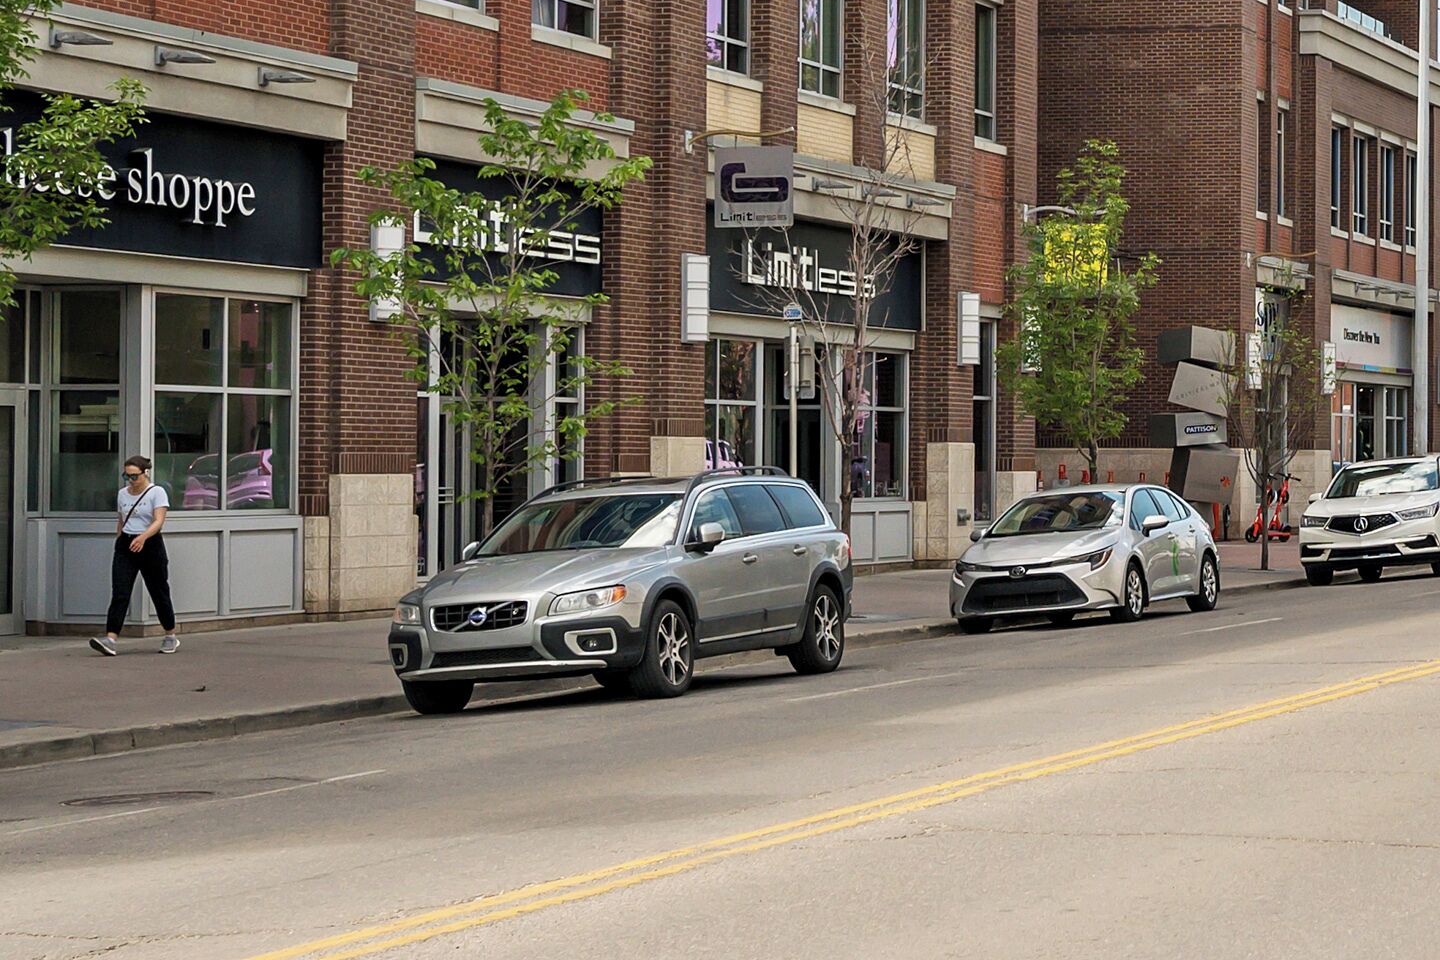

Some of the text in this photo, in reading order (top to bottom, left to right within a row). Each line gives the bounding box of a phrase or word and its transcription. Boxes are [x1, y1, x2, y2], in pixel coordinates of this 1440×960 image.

[2, 127, 256, 228] hee shoppe
[720, 211, 788, 222] Limitless
[747, 239, 876, 298] Limitless
[1343, 327, 1358, 342] Discover
